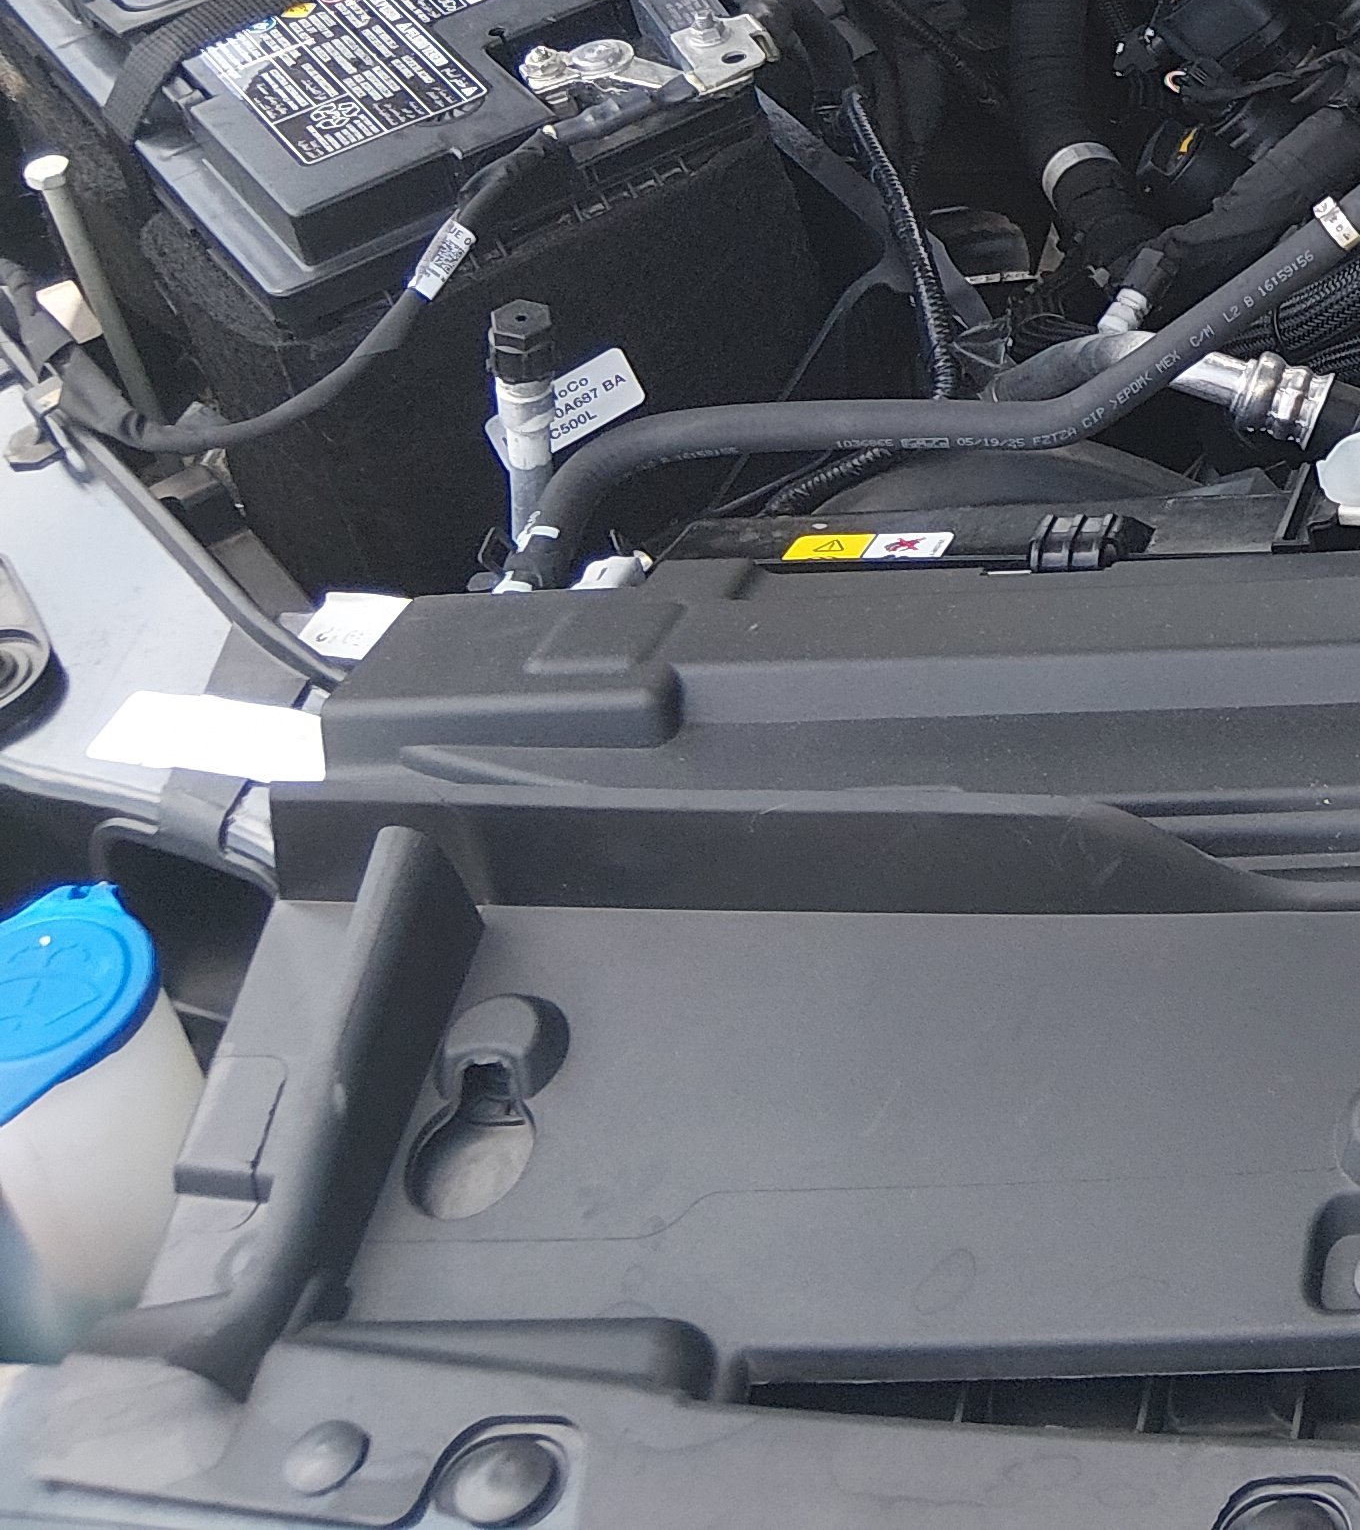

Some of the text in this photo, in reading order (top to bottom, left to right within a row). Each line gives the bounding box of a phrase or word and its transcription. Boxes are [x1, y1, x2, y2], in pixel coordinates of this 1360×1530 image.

[1155, 350, 1182, 373] MEX
[1222, 305, 1243, 323] L2
[554, 374, 627, 419] 0A687 BA
[550, 410, 597, 440] C500L
